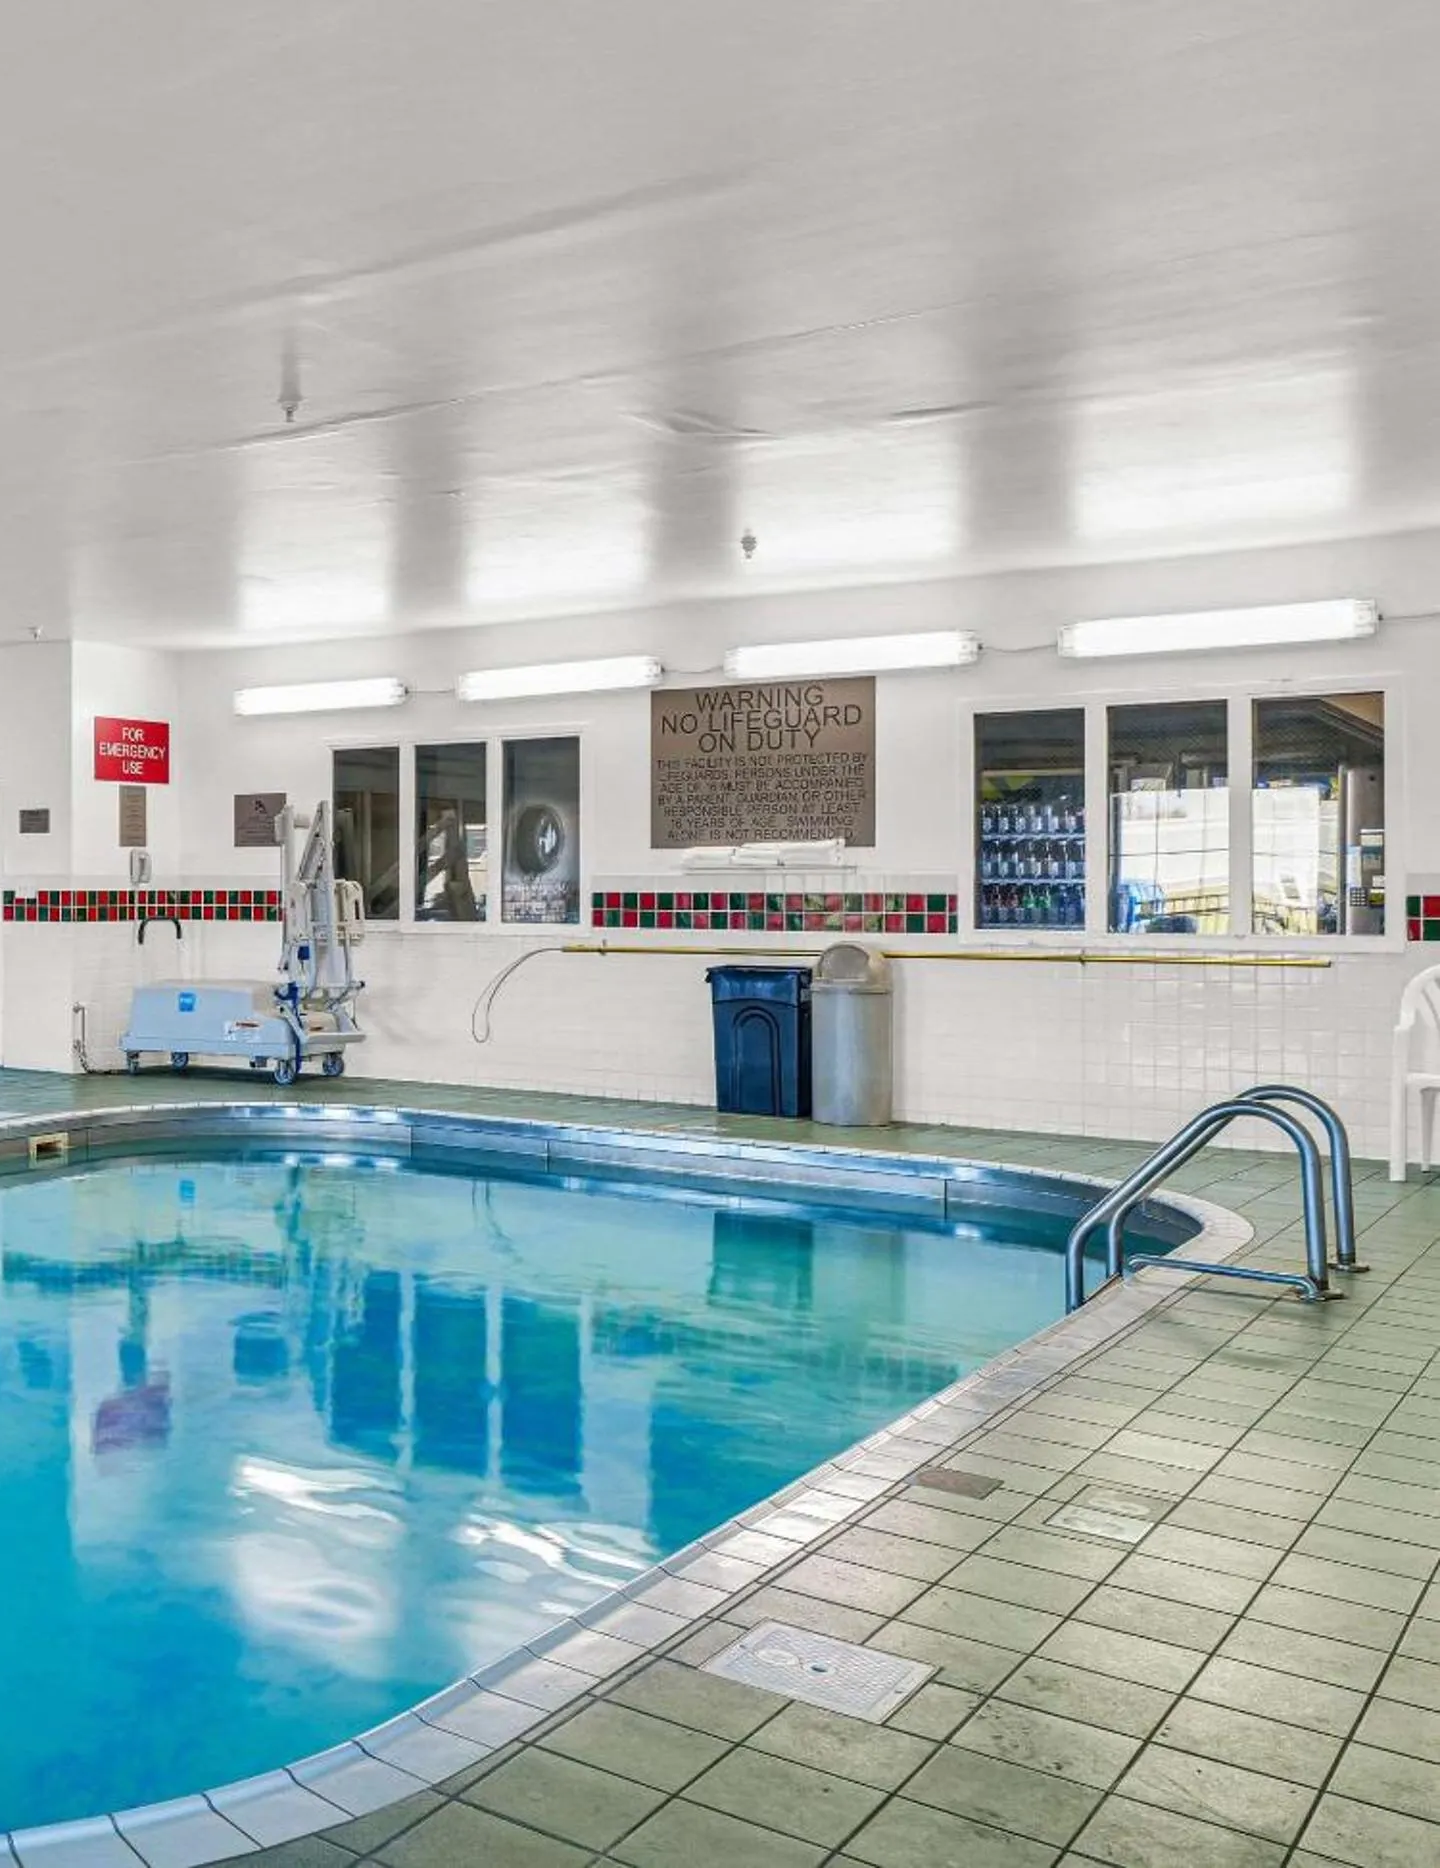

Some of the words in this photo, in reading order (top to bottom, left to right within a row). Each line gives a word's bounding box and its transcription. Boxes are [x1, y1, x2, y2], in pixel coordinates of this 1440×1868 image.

[695, 684, 824, 713] WARNING
[661, 713, 698, 734] NO
[709, 704, 862, 731] LIFEGUARD
[122, 727, 144, 741] FOR
[698, 732, 736, 753] ON
[748, 727, 822, 752] DUTY
[99, 742, 166, 760] EMERGENCY
[122, 761, 143, 774] USE
[685, 757, 733, 769] FACILITY
[734, 756, 746, 767] IS
[751, 755, 772, 767] NOT
[777, 752, 850, 765] PROTECTED
[852, 752, 867, 763] BY
[735, 767, 790, 779] PERSONS
[794, 765, 836, 777] UNDER
[841, 763, 865, 776] THE
[660, 783, 683, 794] AGE
[720, 781, 753, 792] MUST
[775, 777, 864, 790] ACCOMPANIED
[658, 795, 673, 806] BY
[802, 790, 821, 802] OR
[823, 788, 867, 801] OTHER
[664, 804, 742, 817] RESPONSIBLE
[747, 803, 797, 815] PERSON
[821, 802, 861, 814] LEAST
[687, 817, 725, 828] YEARS
[730, 817, 744, 828] OF
[787, 815, 854, 828] SWIMMING
[710, 829, 721, 840] IS
[725, 829, 749, 840] NOT
